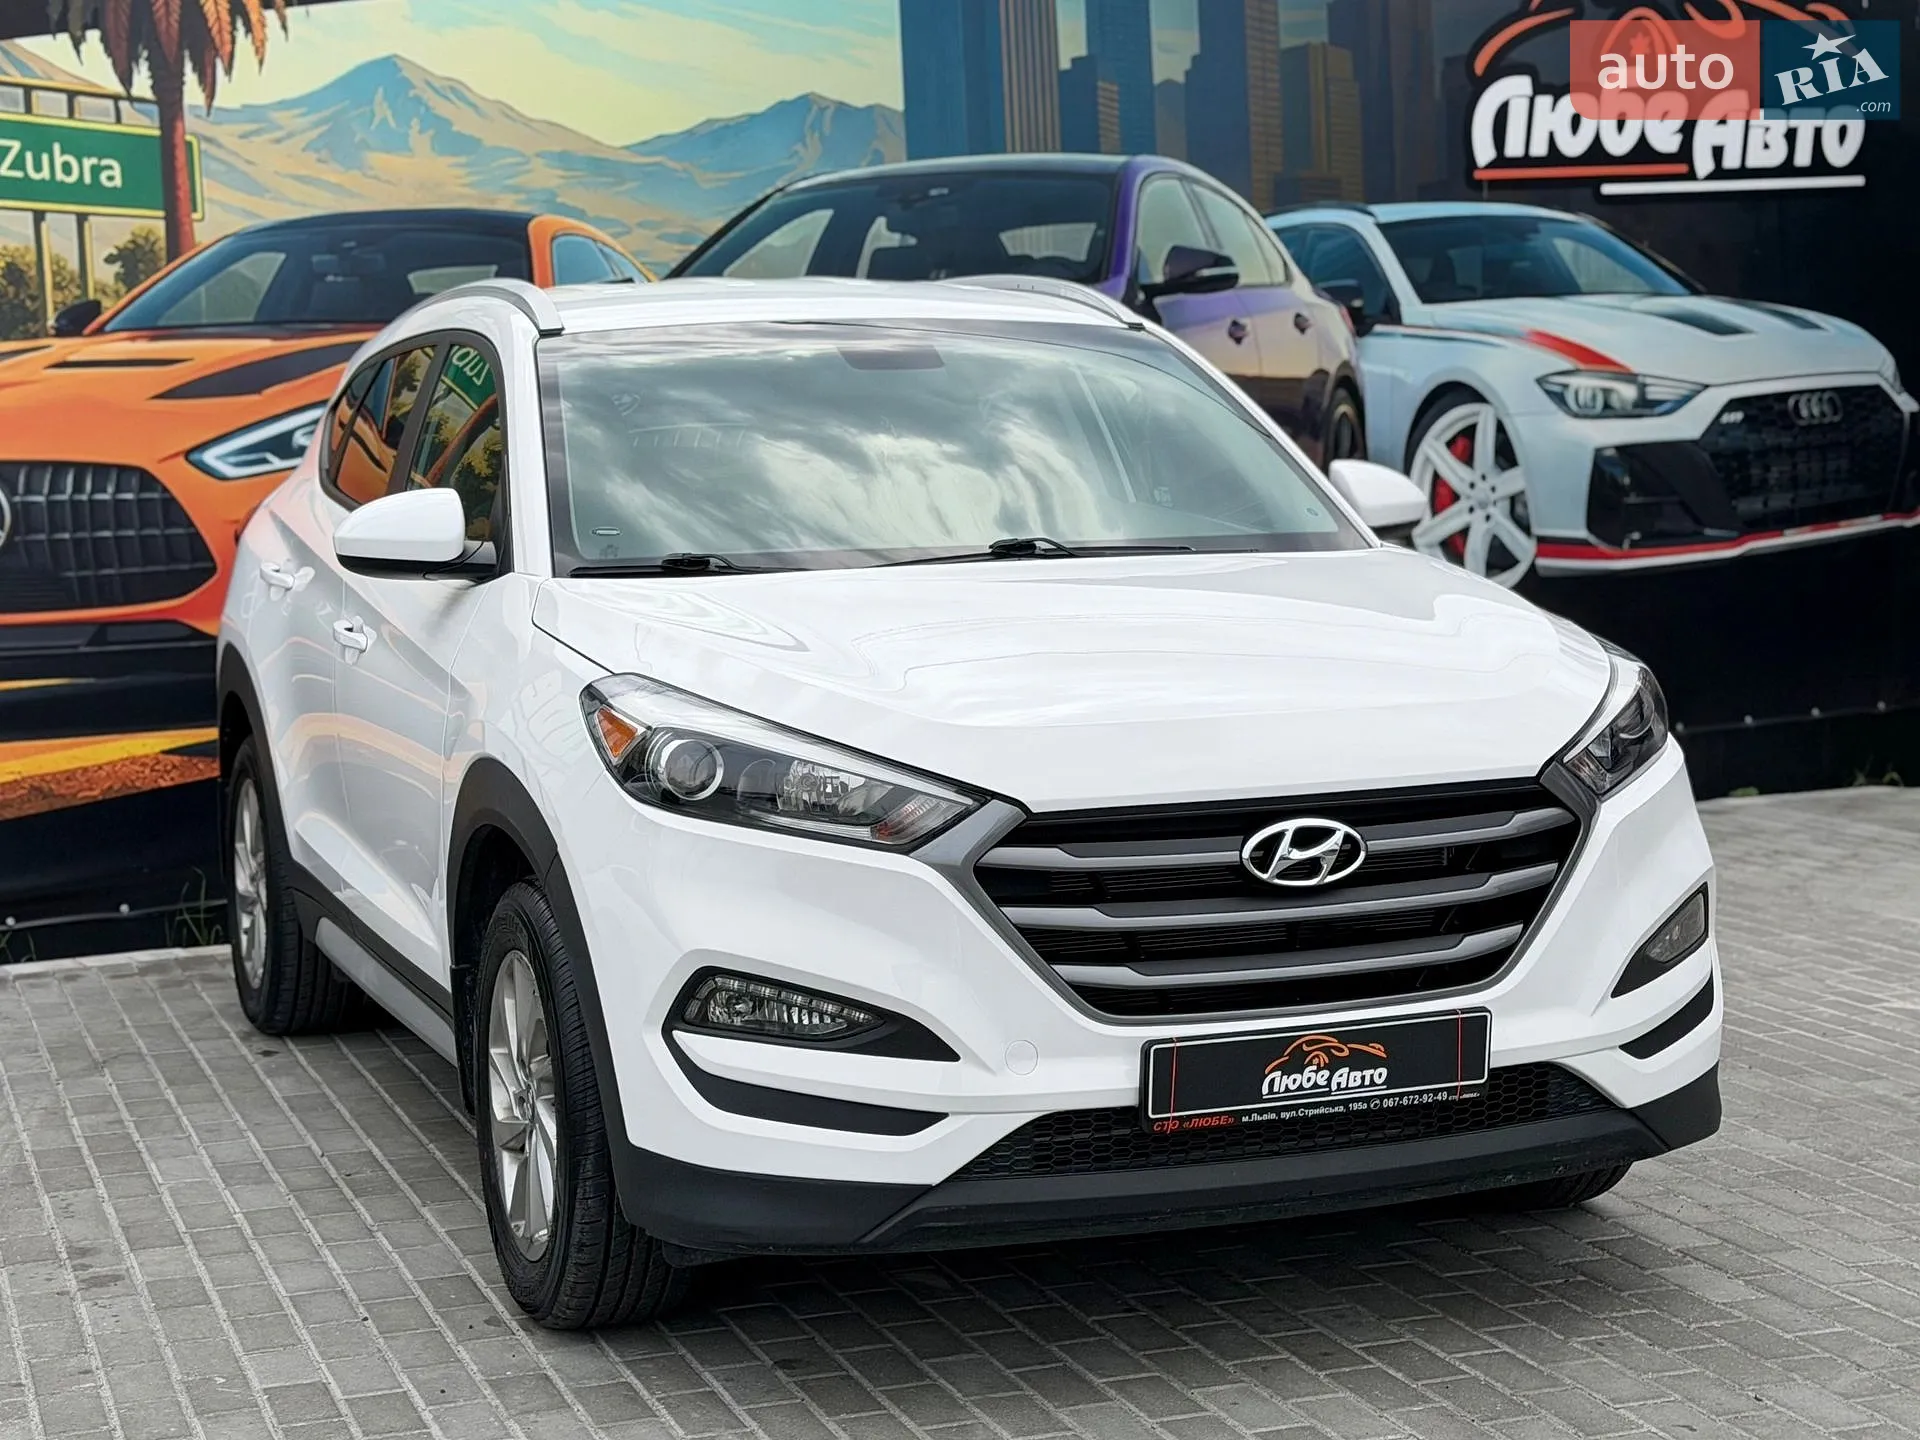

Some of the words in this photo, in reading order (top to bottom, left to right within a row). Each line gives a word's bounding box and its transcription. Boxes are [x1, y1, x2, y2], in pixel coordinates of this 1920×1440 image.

[1471, 67, 1689, 168] Любе
[0, 138, 123, 188] Zubra
[1261, 1065, 1330, 1095] Любе
[1331, 1067, 1388, 1091] Авто
[1153, 1120, 1180, 1131] СТО
[1183, 1115, 1235, 1128] «ЛЮБЕ»
[1382, 1091, 1448, 1108] 067-672-92-49
